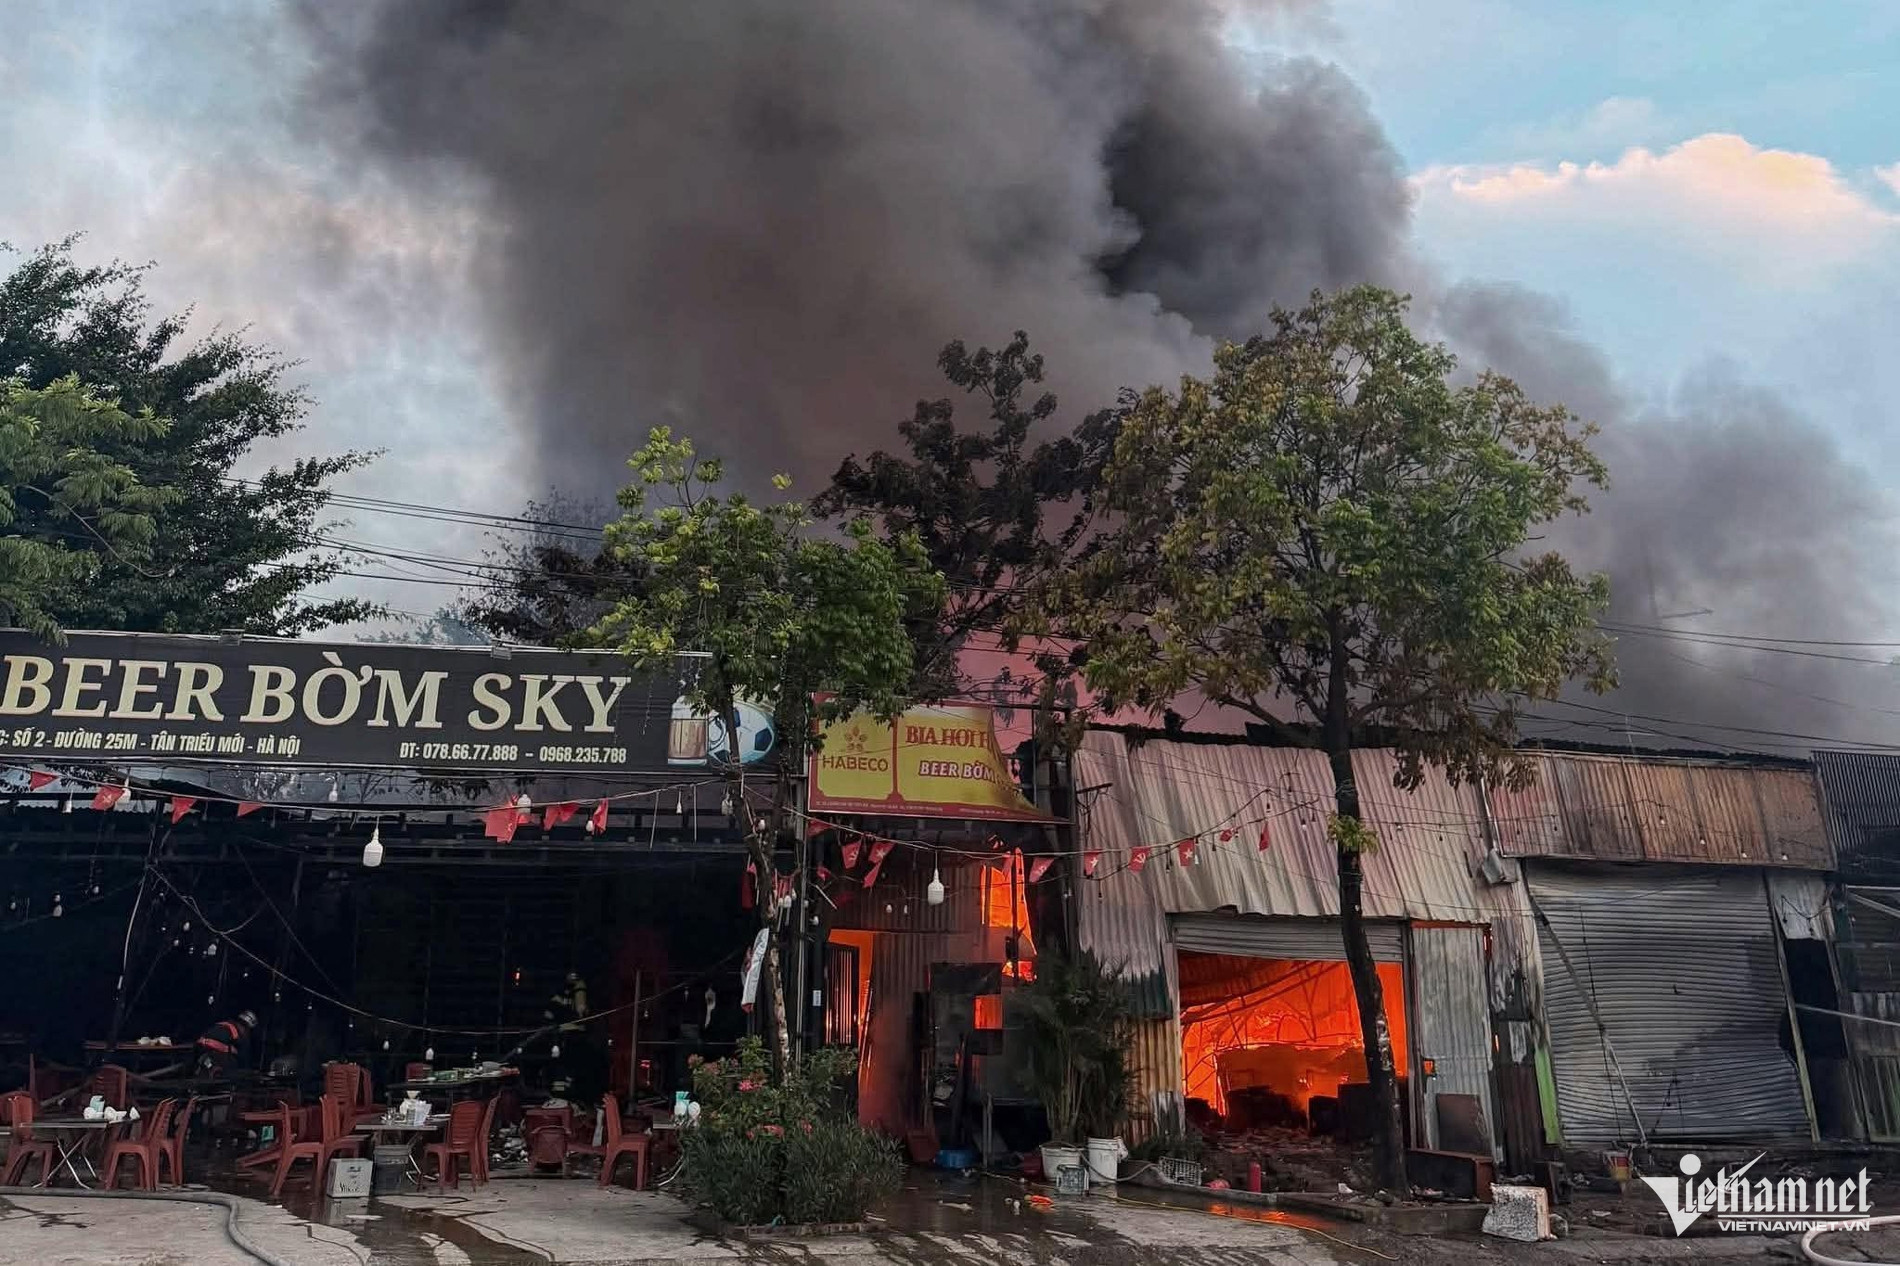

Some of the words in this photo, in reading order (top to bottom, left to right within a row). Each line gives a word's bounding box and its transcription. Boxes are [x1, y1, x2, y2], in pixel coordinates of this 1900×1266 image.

[0, 655, 225, 721] BEER
[240, 651, 448, 727] BỜM
[468, 673, 631, 733] SKY
[12, 726, 35, 747] SỐ
[33, 731, 46, 747] 2
[104, 733, 138, 750] 25M
[151, 731, 176, 751] TÂN
[256, 735, 275, 754] HÀ
[278, 735, 300, 757] NỘI
[905, 725, 938, 745] BIA
[423, 743, 518, 761] 078.66.77.888
[539, 747, 627, 763] 0968.235.788
[823, 756, 888, 772] HABECO
[919, 761, 958, 777] BEER
